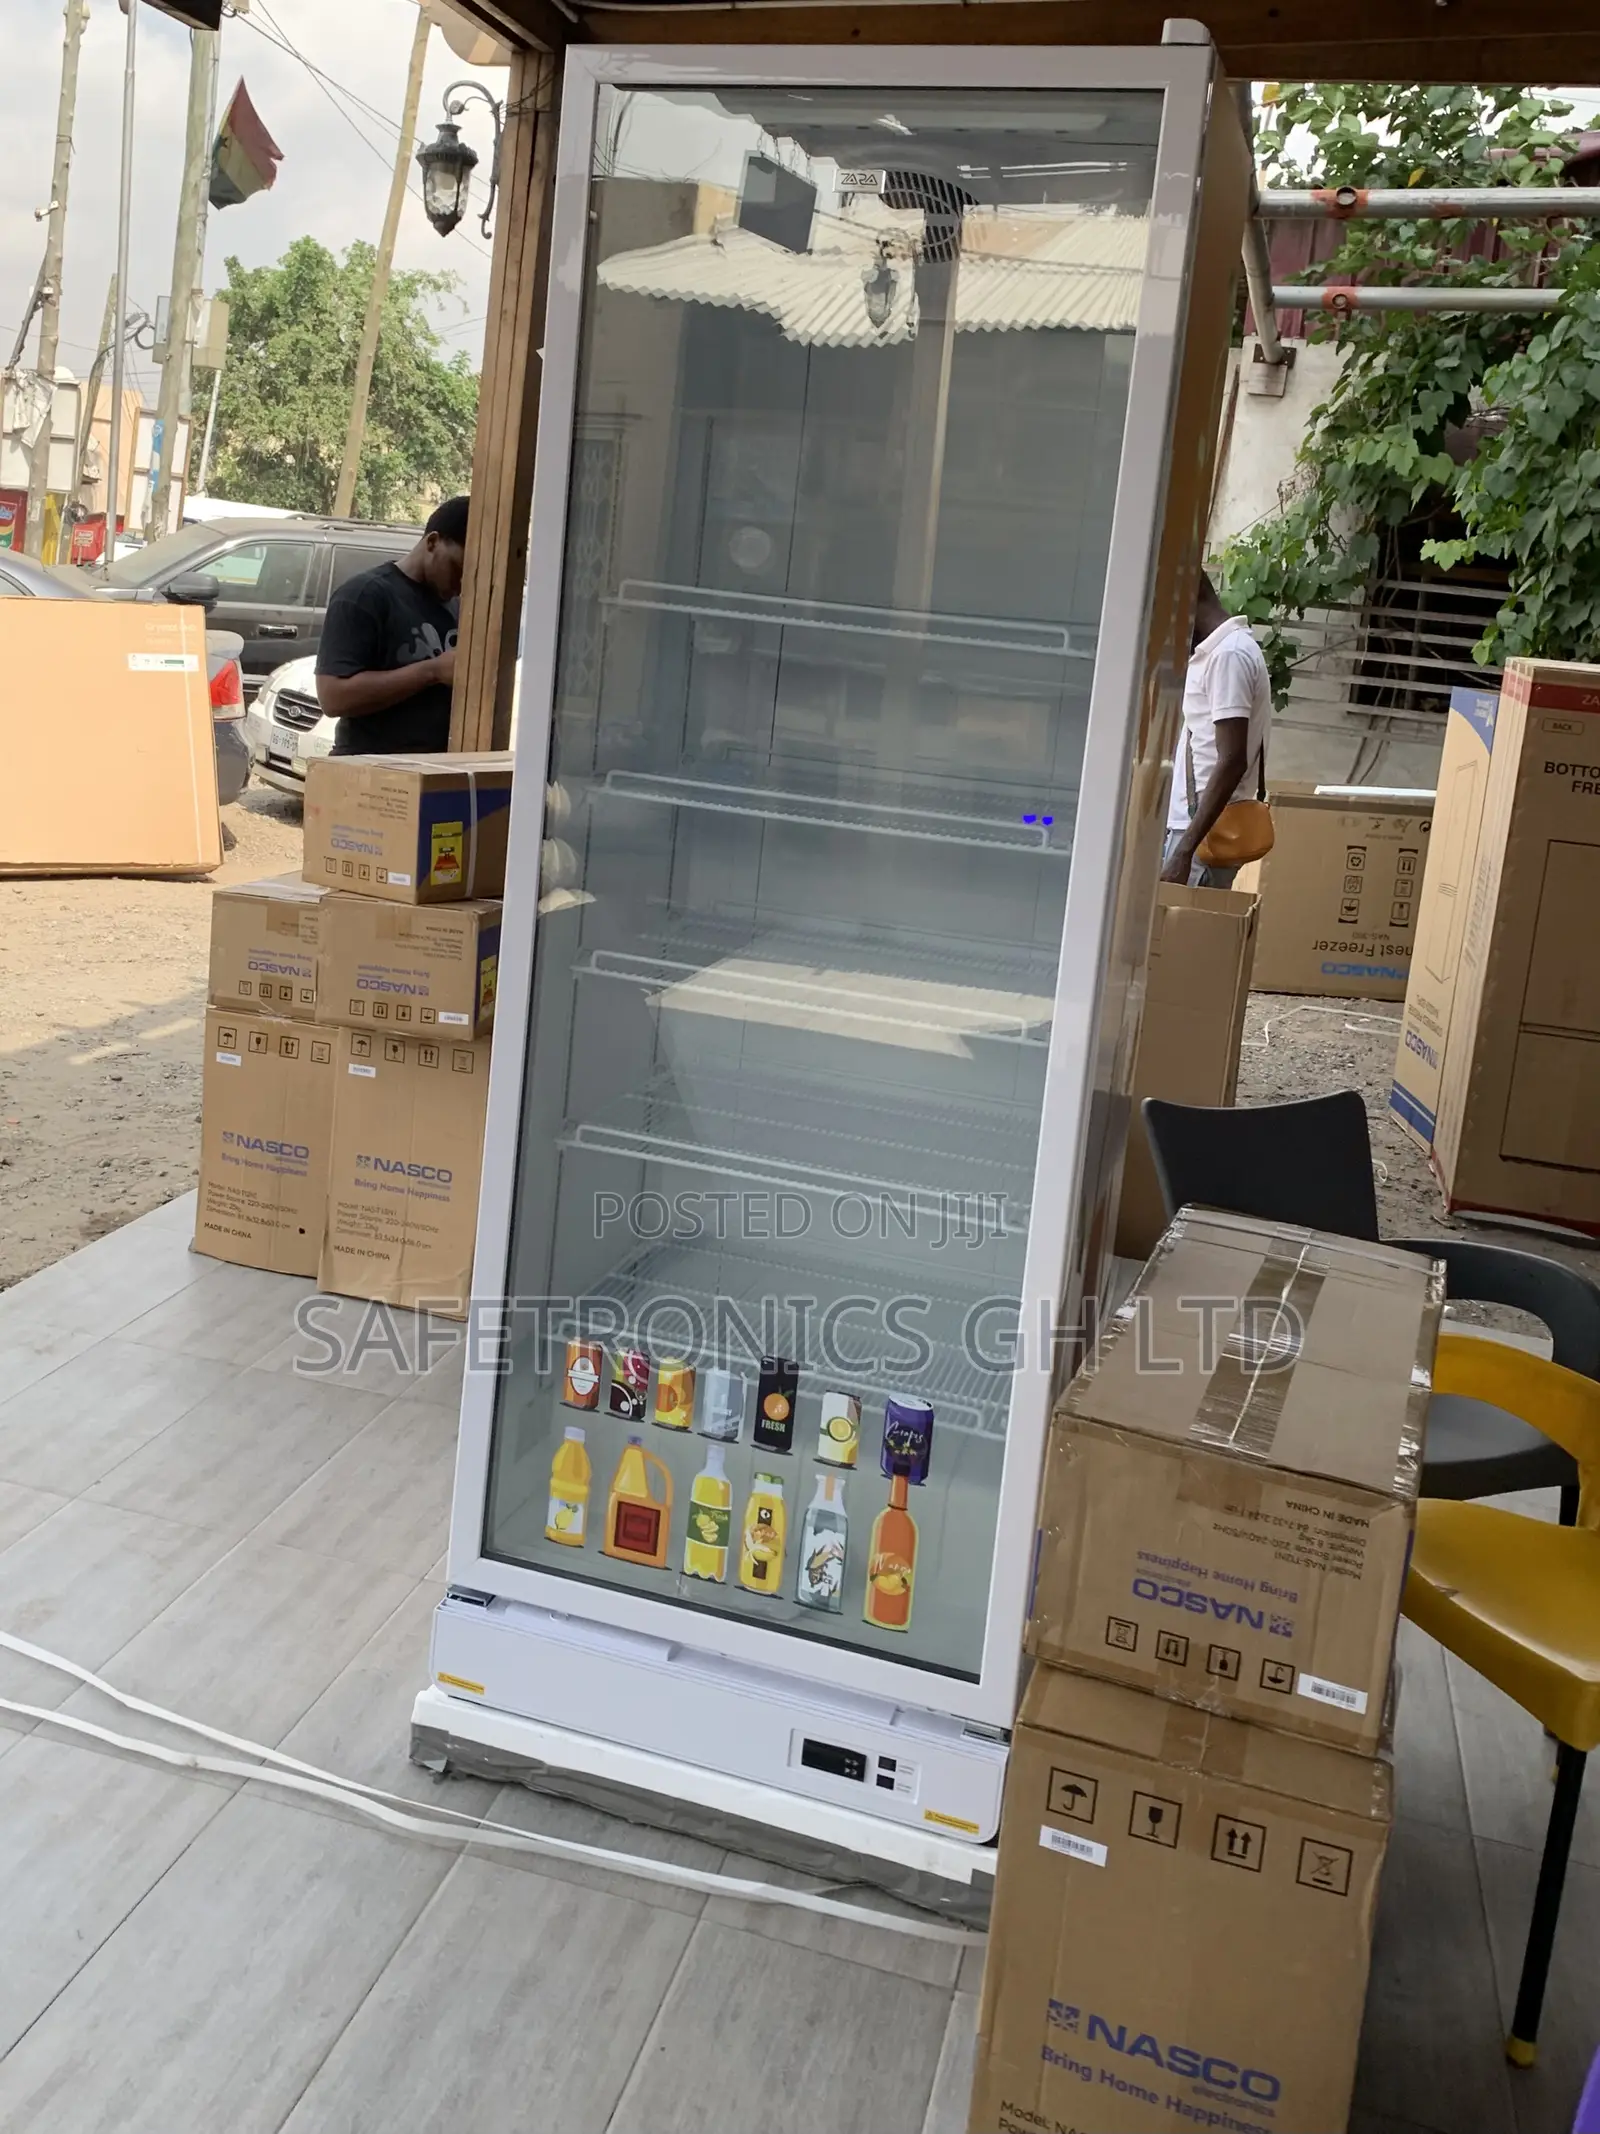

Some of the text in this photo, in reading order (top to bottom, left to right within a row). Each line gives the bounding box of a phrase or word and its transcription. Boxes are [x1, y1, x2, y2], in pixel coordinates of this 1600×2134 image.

[840, 173, 878, 185] ZARA
[1552, 722, 1573, 732] BACK
[331, 838, 373, 855] NASCO
[1312, 940, 1375, 957] Freezer
[248, 960, 301, 974] NASCO
[1321, 962, 1397, 979] NASCO
[356, 978, 417, 995] NASCO
[1405, 1030, 1433, 1066] NASCO
[236, 1135, 310, 1159] NASCO
[374, 1158, 453, 1183] NASCO
[354, 1178, 451, 1202] Bring Home Happiness
[203, 1221, 252, 1240] MADE IN CHINA
[333, 1244, 391, 1260] MADE IN CHINA
[761, 1418, 787, 1434] FRESH
[1285, 1500, 1370, 1528] MADE IN CHINA
[1313, 1526, 1367, 1548] Dimension:
[1334, 1554, 1364, 1570] Power
[1136, 1550, 1298, 1603] Bring Home Happiness
[1132, 1578, 1264, 1630] NASCO
[1087, 2014, 1282, 2102] NASCO
[1040, 2044, 1093, 2082] Bring
[1098, 2068, 1161, 2105] Home
[1191, 2084, 1277, 2119] electronics
[1001, 2099, 1051, 2130] Model:
